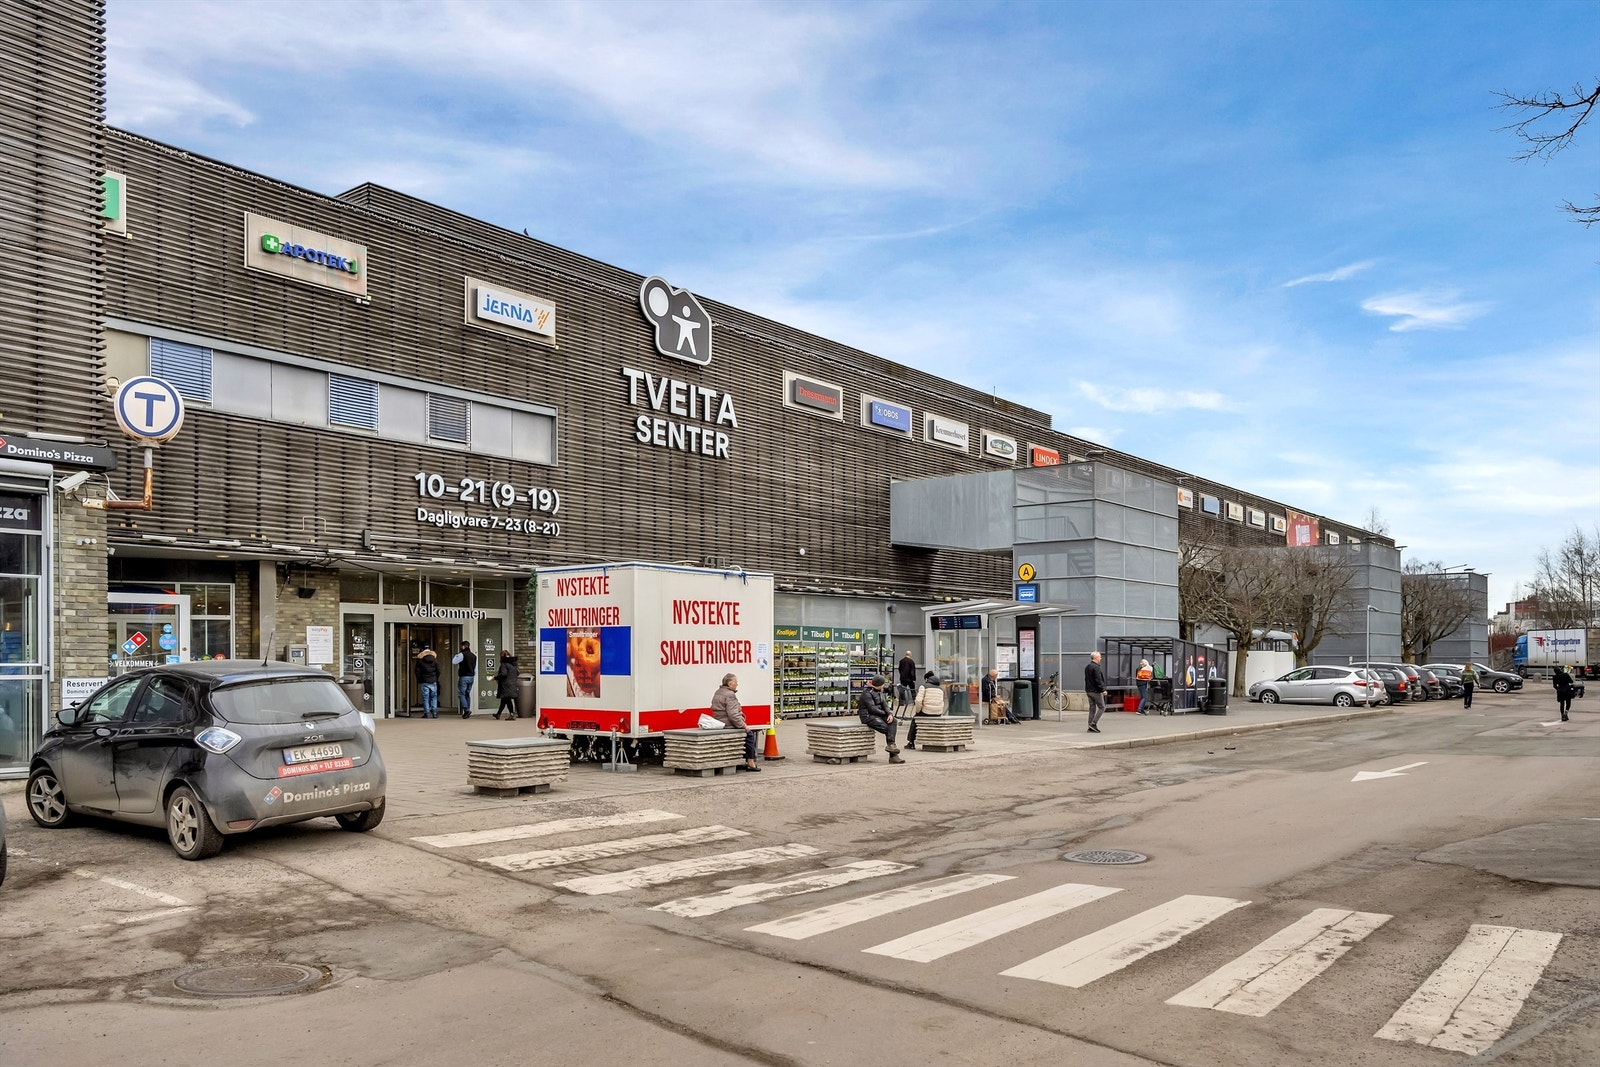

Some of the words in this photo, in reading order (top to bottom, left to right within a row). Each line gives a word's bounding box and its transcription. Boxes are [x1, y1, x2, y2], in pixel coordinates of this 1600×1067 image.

[282, 241, 347, 272] APOTEK
[622, 367, 739, 428] TVEITA
[799, 386, 837, 405] Dressmann
[134, 391, 166, 427] T
[883, 408, 899, 420] OBOS
[635, 415, 730, 459] SENTER
[7, 444, 61, 459] Domino's
[63, 451, 94, 463] Pizza
[1035, 452, 1058, 465] LINDEX
[417, 507, 489, 529] Dagligvare
[557, 575, 610, 597] NYSTEKTE
[408, 603, 487, 620] Velkommen
[548, 606, 620, 627] SMULTRINGER
[673, 599, 740, 626] NYSTEKTE
[568, 631, 598, 639] Smultringer
[660, 640, 752, 666] SMULTRINGER
[114, 660, 154, 668] VELKOMMEN
[293, 750, 307, 760] EK
[311, 745, 340, 758] 44690
[324, 760, 333, 769] TLF
[283, 785, 341, 803] Domino's
[343, 781, 371, 794] Pizza
